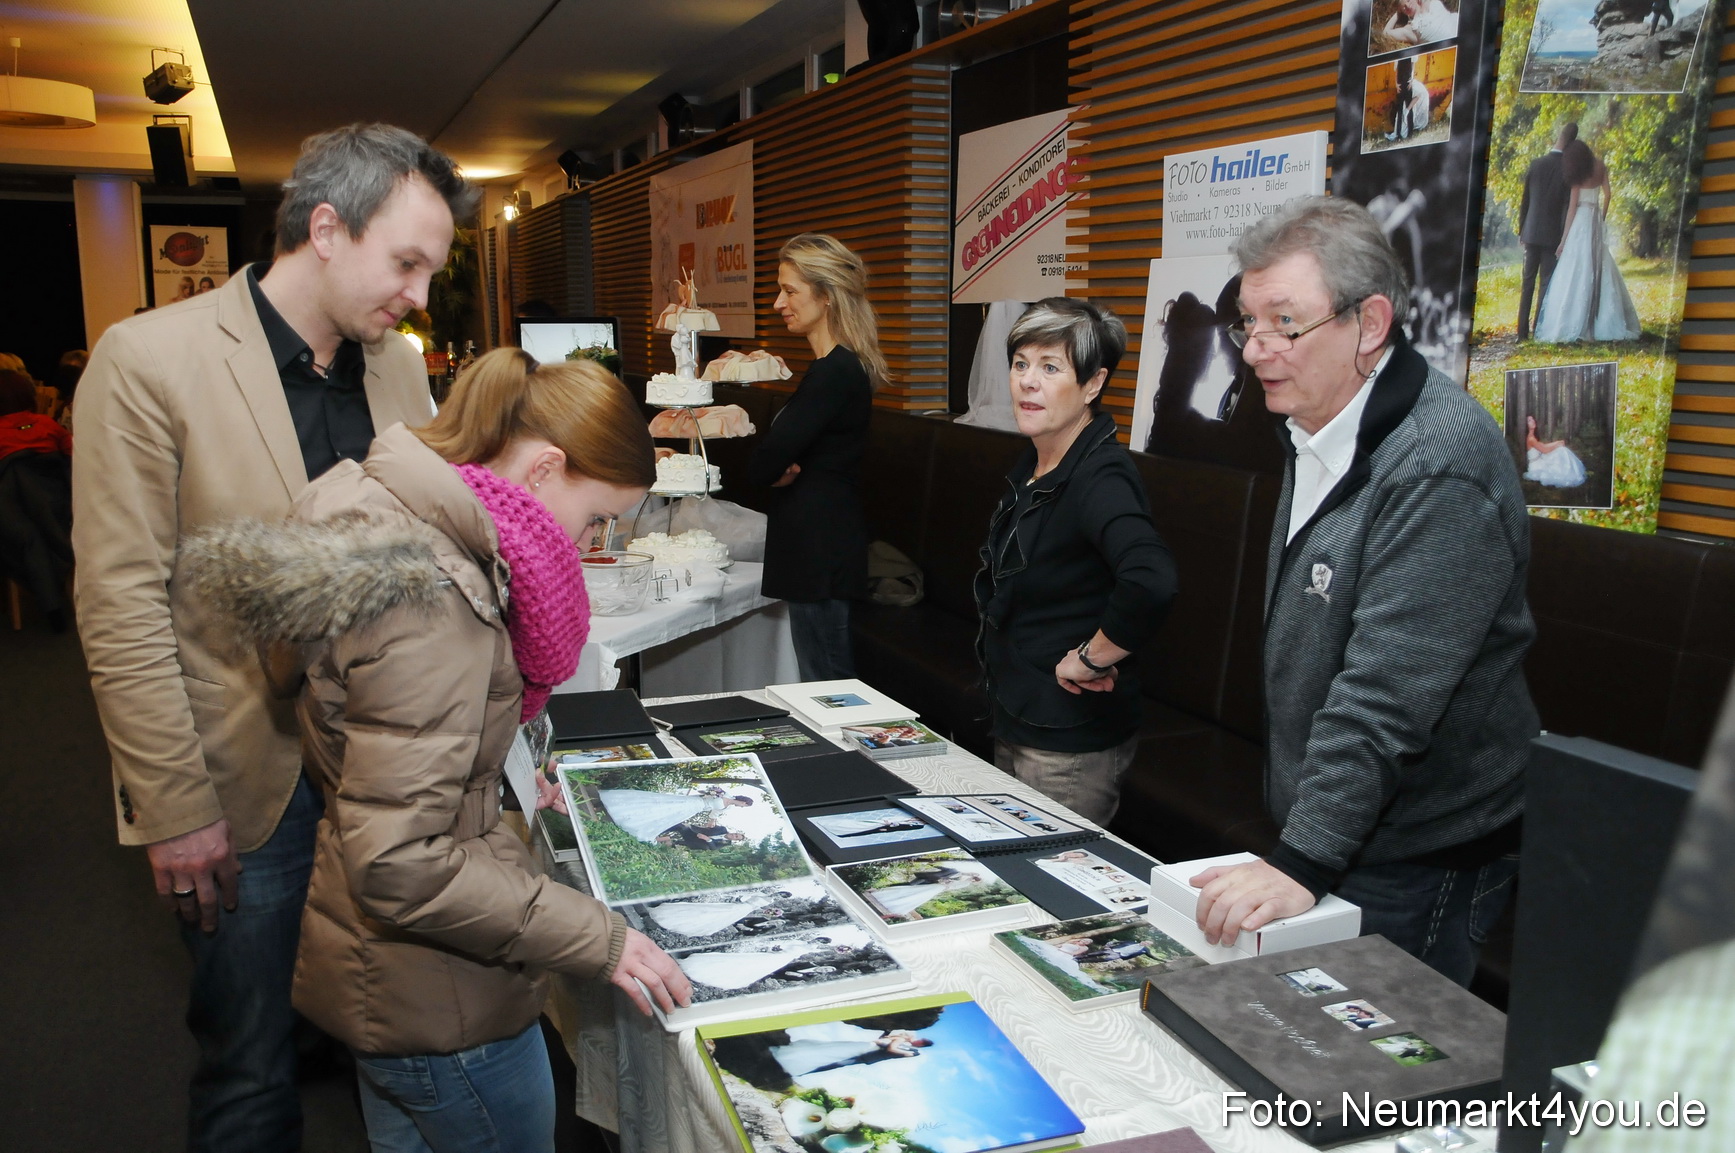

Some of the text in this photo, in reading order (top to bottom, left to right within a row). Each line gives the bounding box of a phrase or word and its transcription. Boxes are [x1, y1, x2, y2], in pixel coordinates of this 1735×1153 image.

[977, 184, 1010, 222] BÄCKEREI
[1018, 138, 1066, 187] KONDITOREI
[1168, 148, 1311, 190] FOTO hailer GmbH
[1168, 179, 1289, 203] Studio Kameras Bilder
[1170, 209, 1212, 224] Viehmarkt
[1214, 206, 1219, 220] 7
[1224, 203, 1252, 219] 92318
[1186, 222, 1247, 240] www.foto-hail
[717, 243, 748, 272] BÜGL
[1037, 254, 1054, 264] 92318
[1048, 266, 1065, 277] 09181
